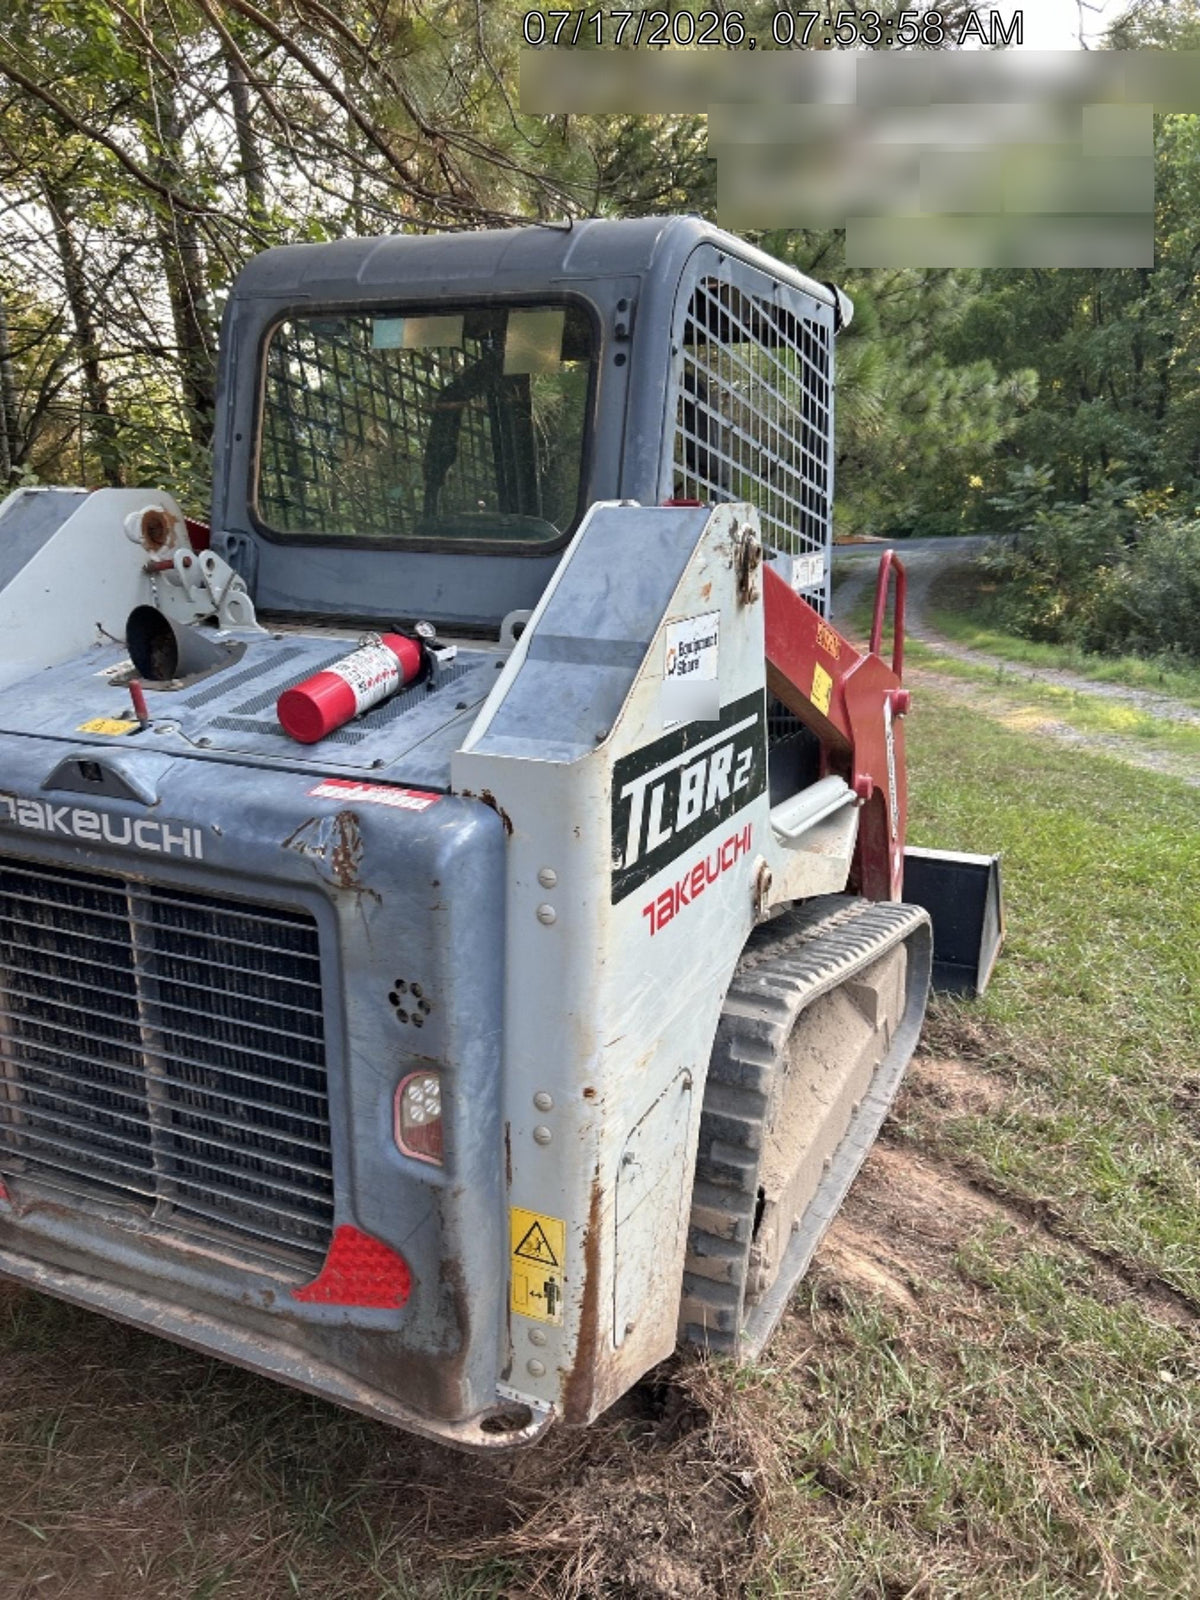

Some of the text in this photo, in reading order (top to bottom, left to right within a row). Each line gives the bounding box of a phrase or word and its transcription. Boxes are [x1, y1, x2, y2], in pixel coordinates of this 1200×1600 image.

[678, 632, 718, 658] Equipment
[676, 658, 700, 676] Share
[642, 823, 753, 936] TAKEUCHI
